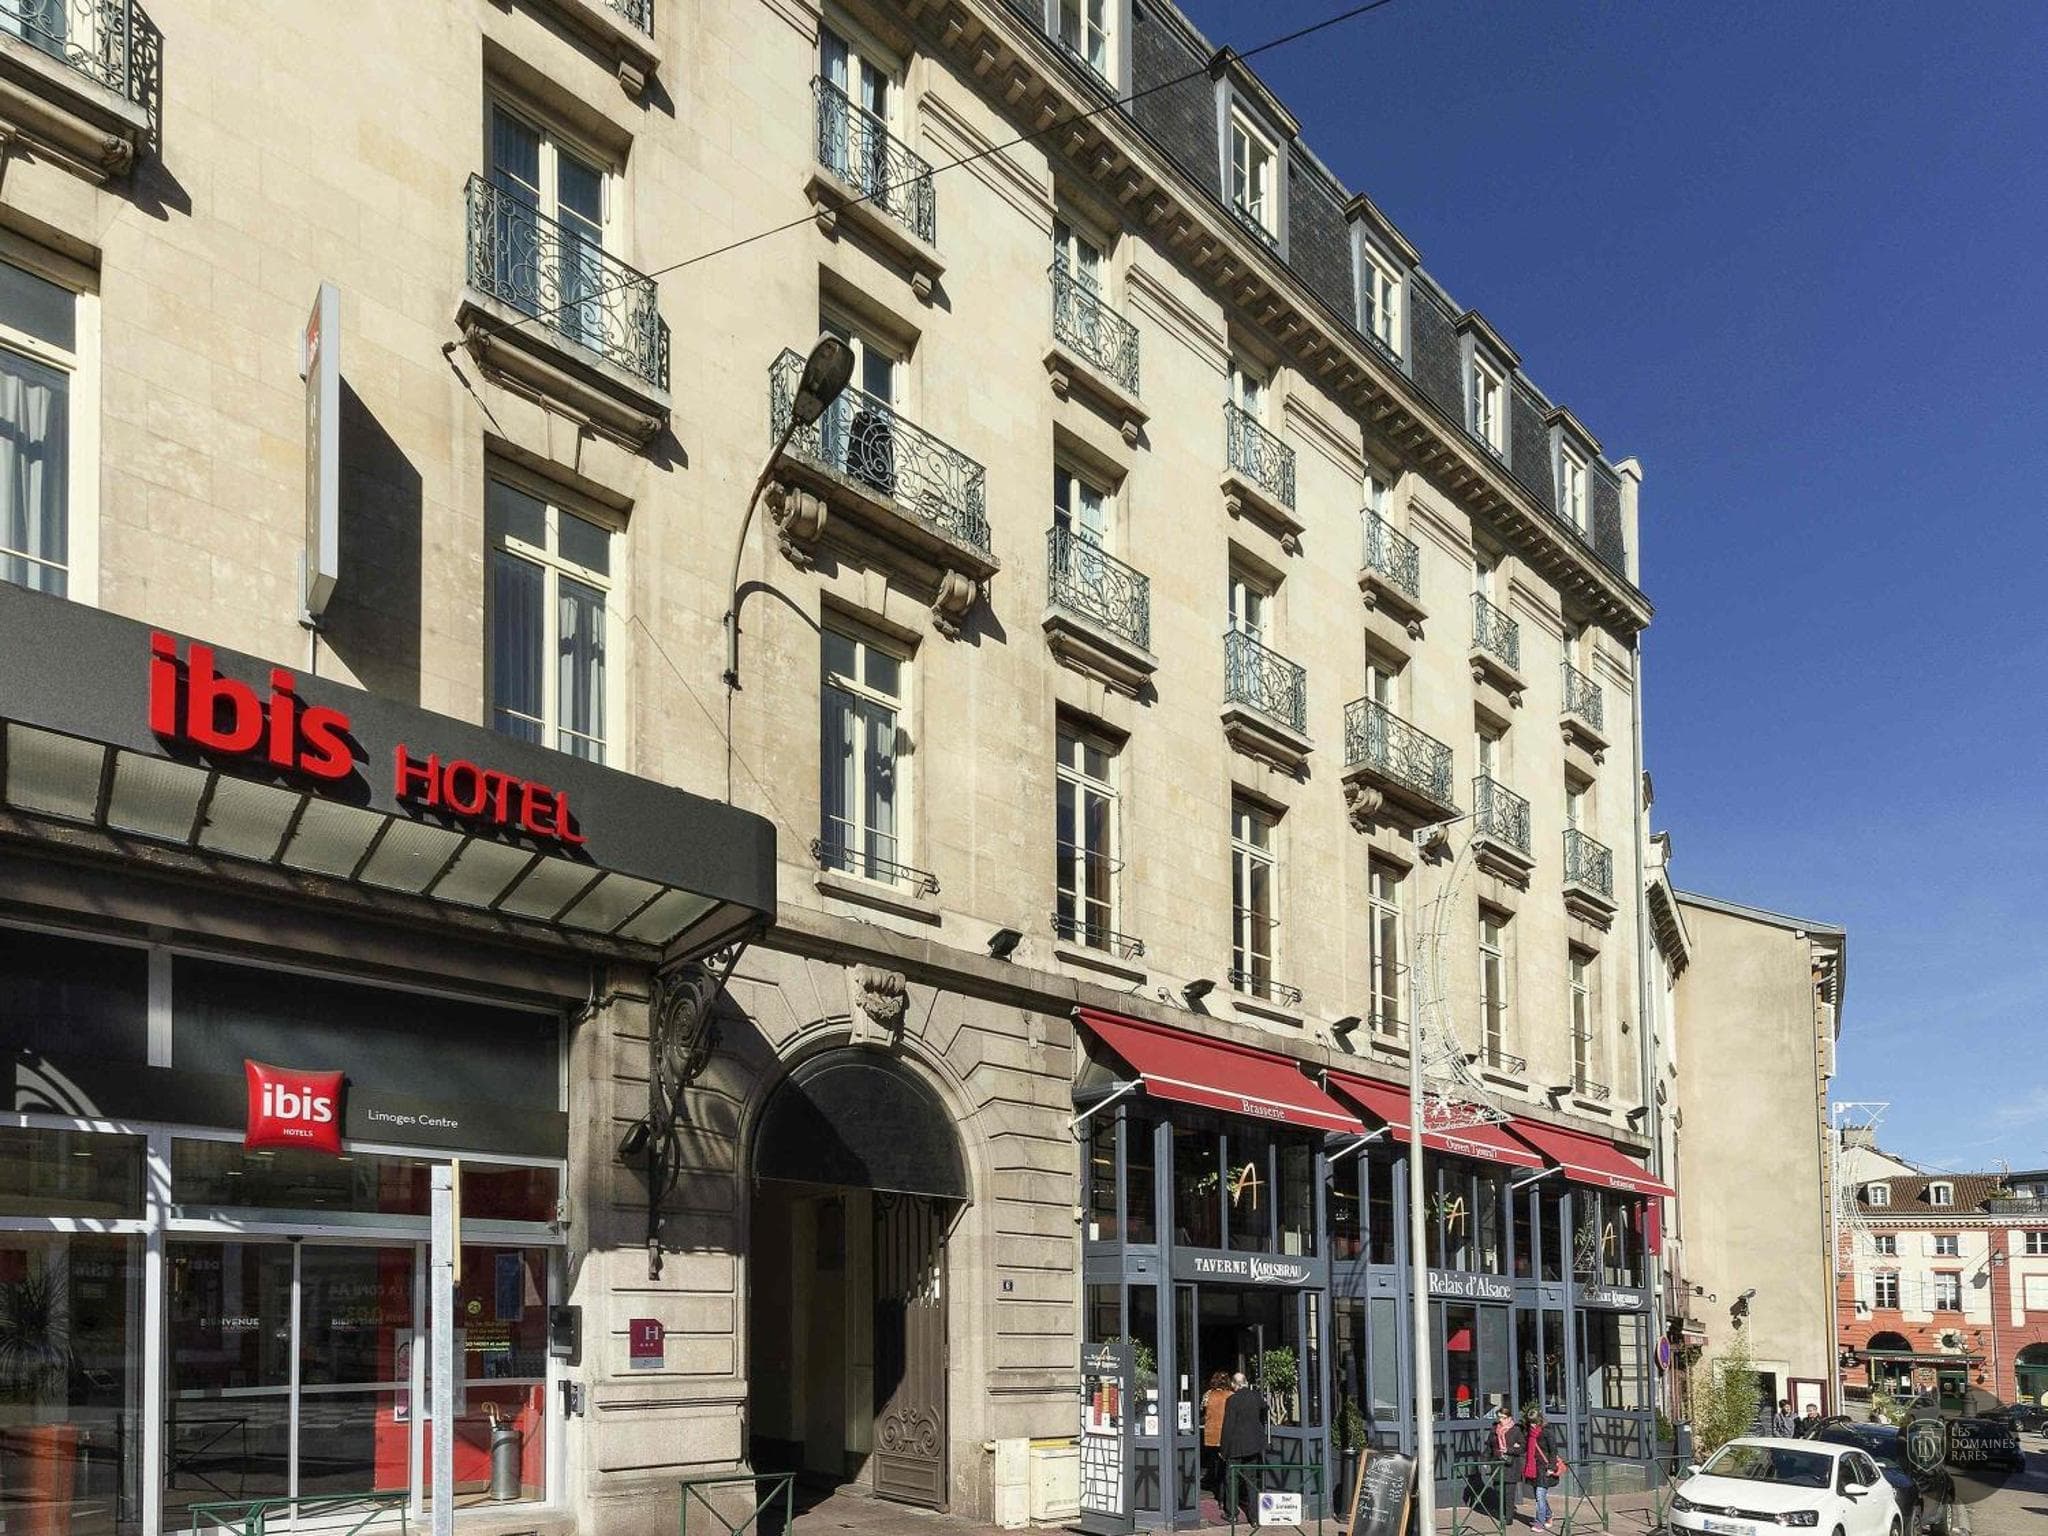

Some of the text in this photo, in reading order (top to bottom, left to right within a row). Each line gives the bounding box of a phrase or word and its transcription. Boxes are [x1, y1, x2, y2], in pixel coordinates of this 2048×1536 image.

[149, 631, 588, 843] ibis HOTEL
[263, 1083, 333, 1123] ibis
[1242, 1099, 1286, 1119] Brasserie
[368, 1109, 459, 1129] Limoges Centre
[283, 1128, 314, 1137] HOTELS
[1194, 1258, 1248, 1274] TAVERNE
[1428, 1272, 1511, 1298] Relais d'Alsace
[645, 1326, 659, 1340] H
